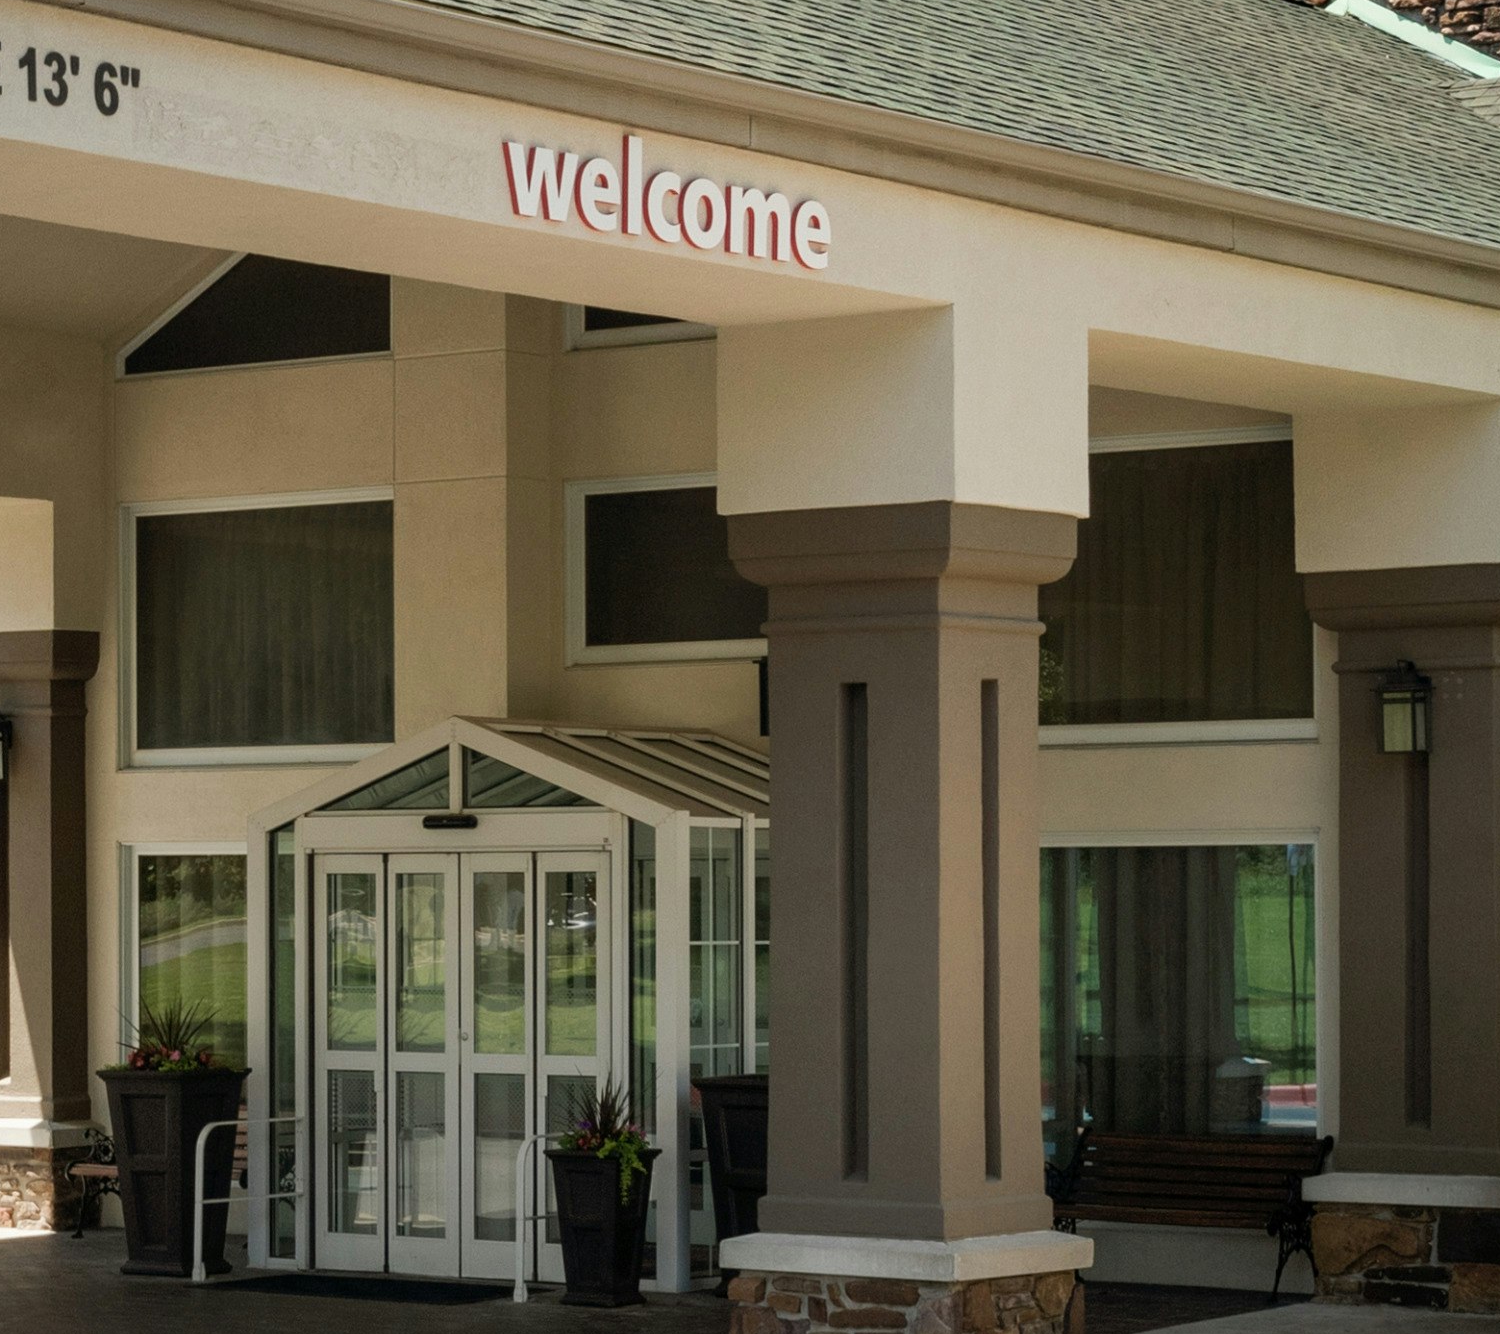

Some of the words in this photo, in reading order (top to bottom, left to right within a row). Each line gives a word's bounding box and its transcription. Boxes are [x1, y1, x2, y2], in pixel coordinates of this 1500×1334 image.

[18, 47, 80, 106] 13'
[93, 62, 140, 116] 6"
[502, 134, 832, 269] welcome
